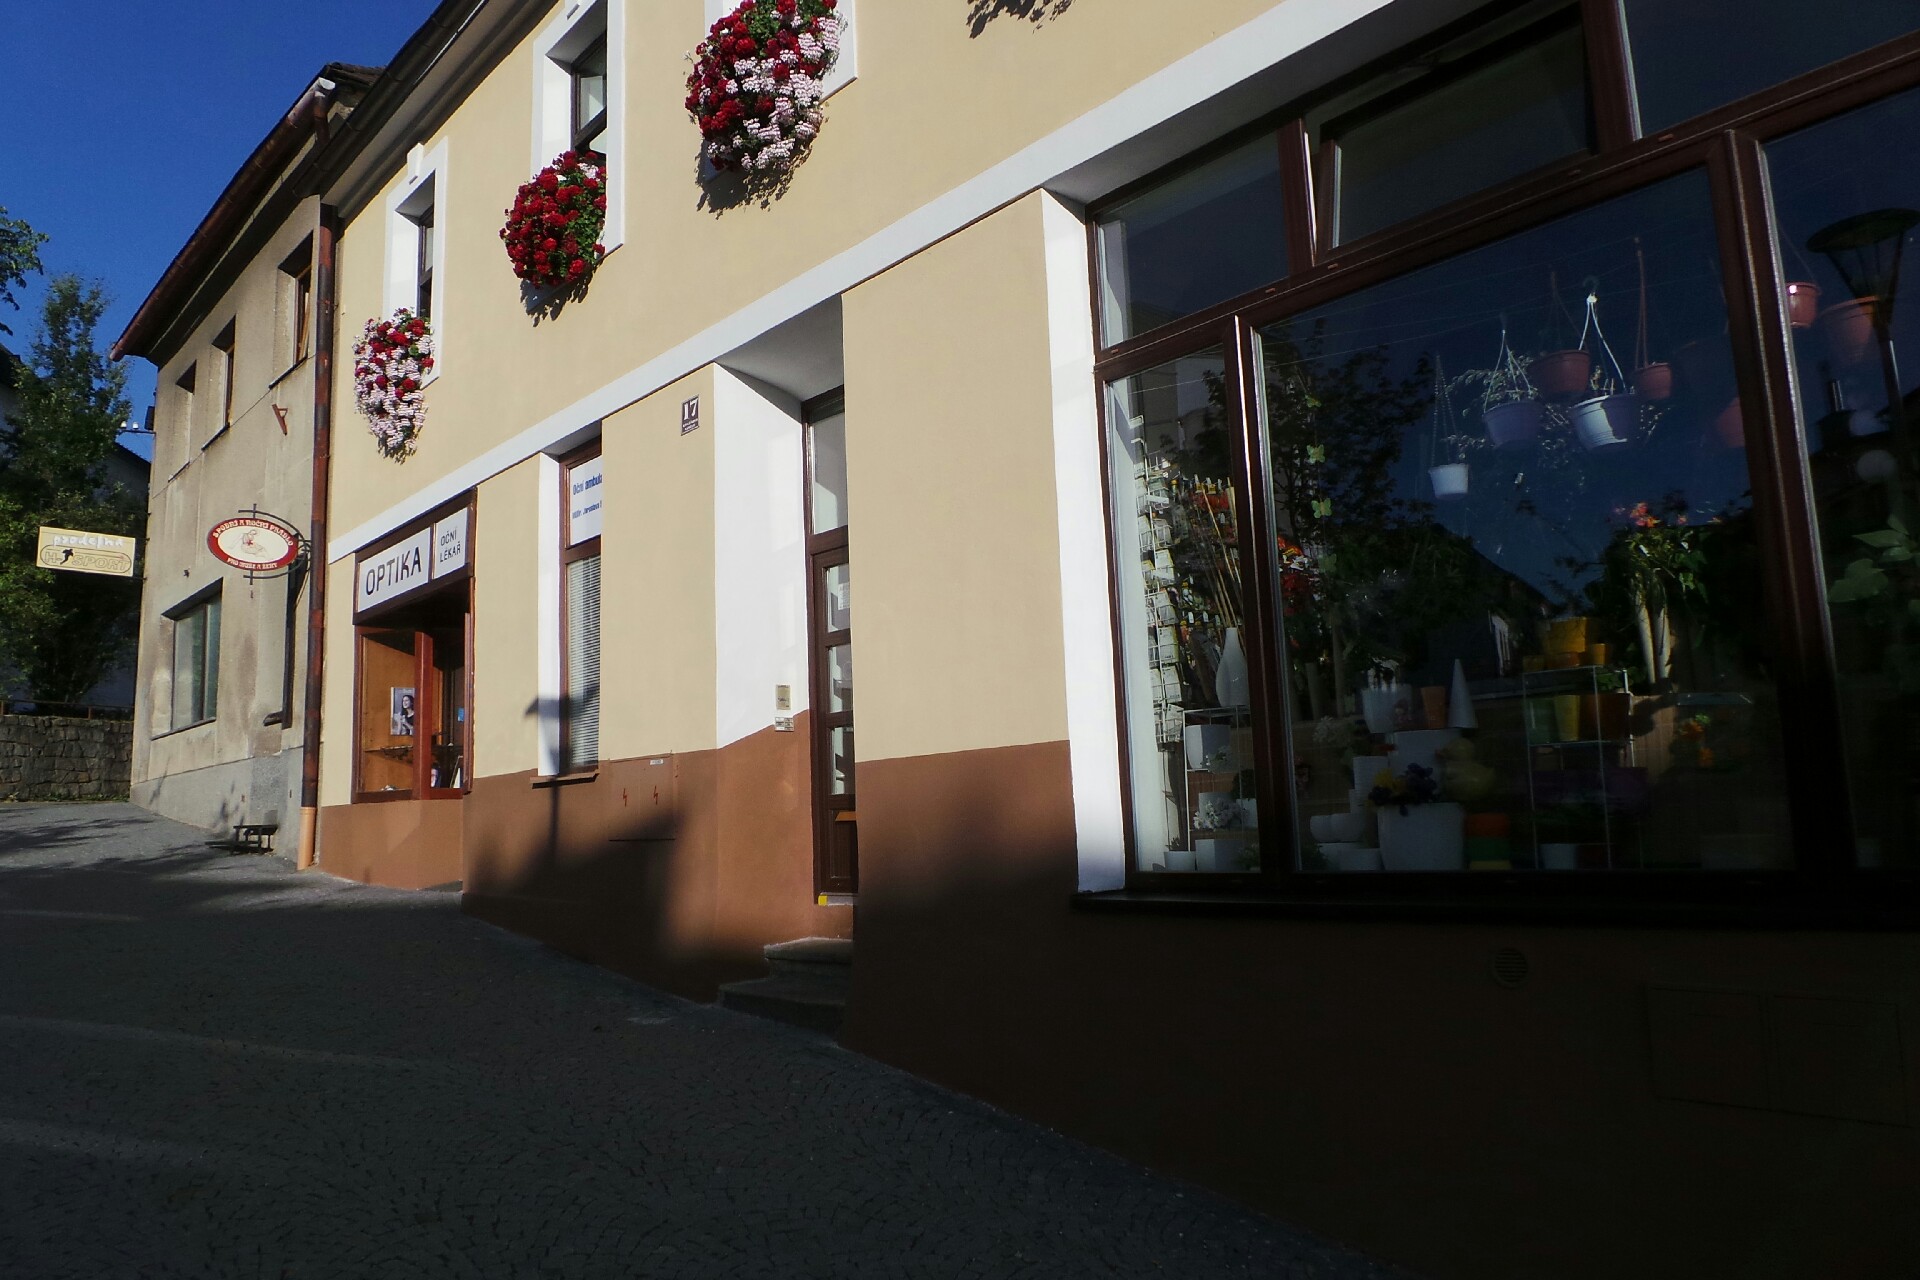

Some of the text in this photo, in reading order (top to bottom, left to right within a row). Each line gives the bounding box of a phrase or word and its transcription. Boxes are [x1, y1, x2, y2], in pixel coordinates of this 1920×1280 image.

[684, 398, 699, 420] 17
[53, 533, 124, 549] prodejna
[440, 526, 457, 546] OČNÍ
[72, 554, 128, 571] SPORT
[440, 541, 461, 563] LÉKAŘ
[366, 546, 421, 596] OPTIKA
